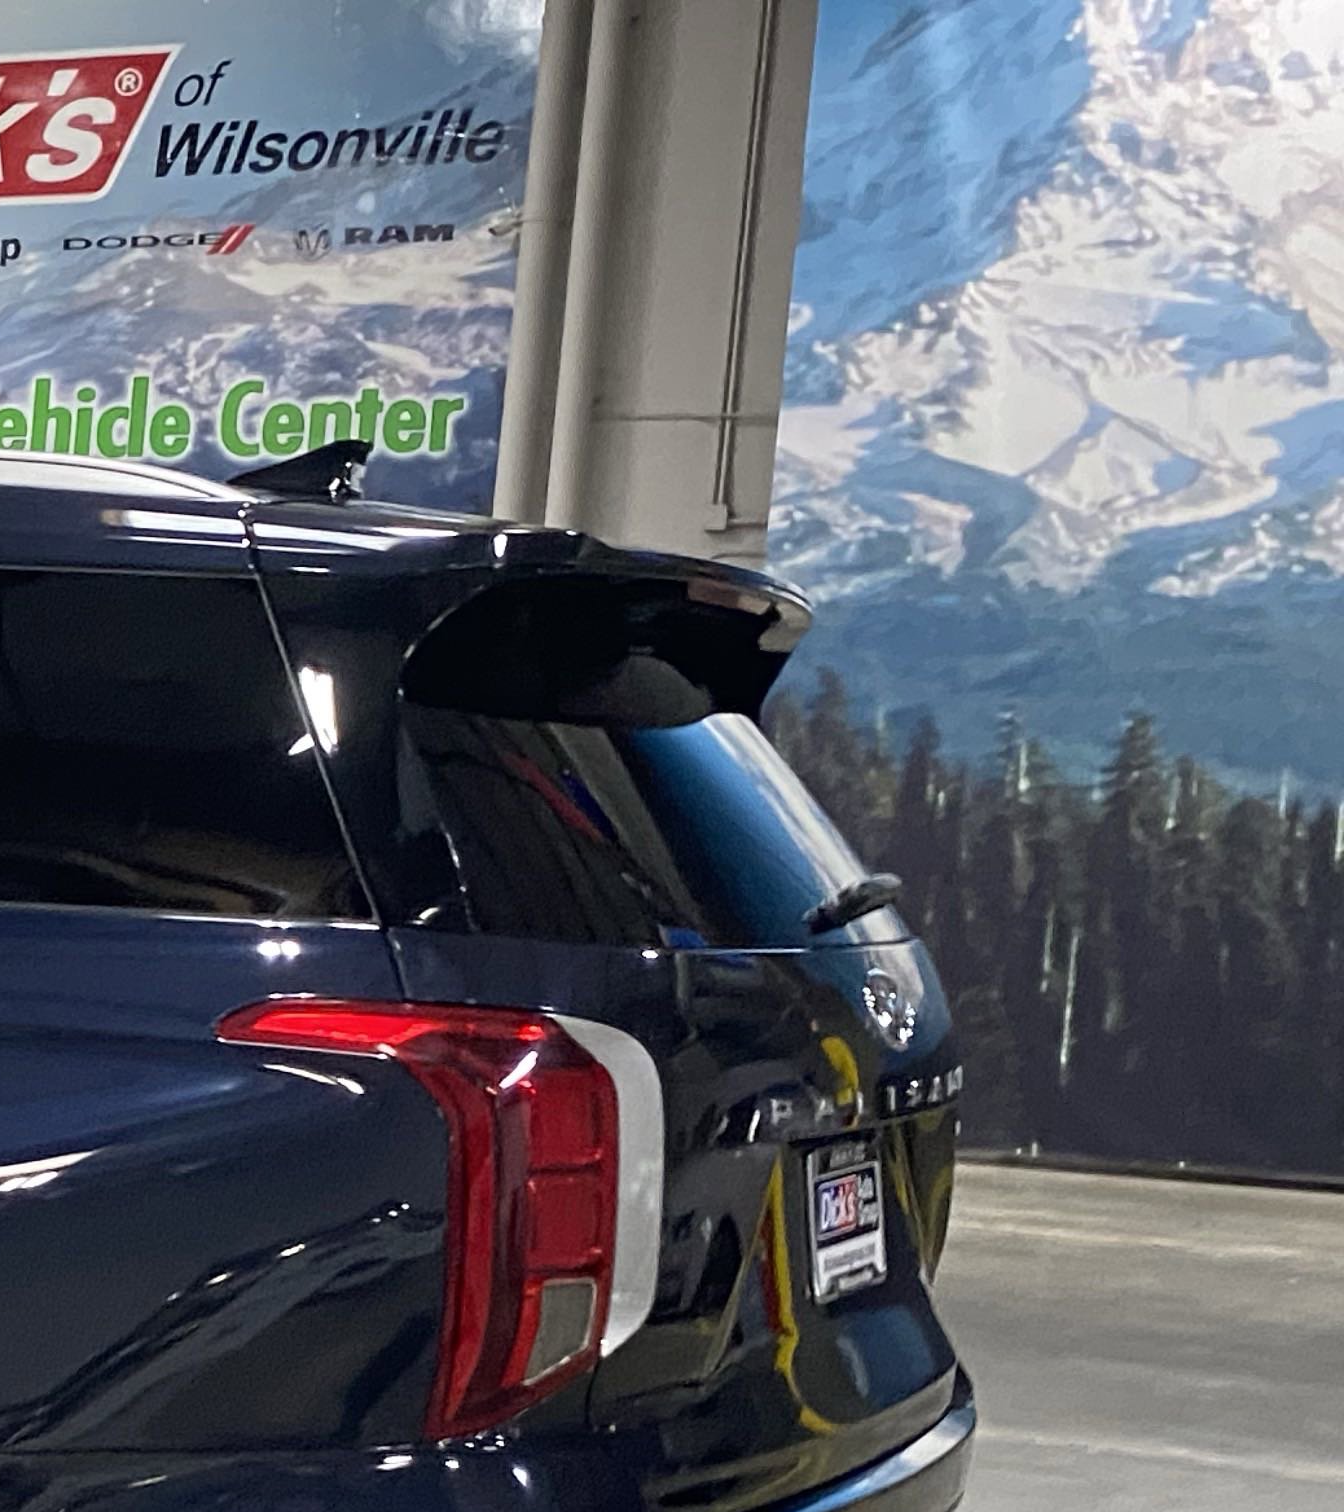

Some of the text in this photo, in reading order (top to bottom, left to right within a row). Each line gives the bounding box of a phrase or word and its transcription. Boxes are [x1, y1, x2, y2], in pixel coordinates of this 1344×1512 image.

[174, 59, 233, 109] of
[153, 107, 505, 179] Wilsonville
[63, 230, 223, 253] DODGE
[344, 222, 455, 247] RAM
[221, 380, 464, 458] Center
